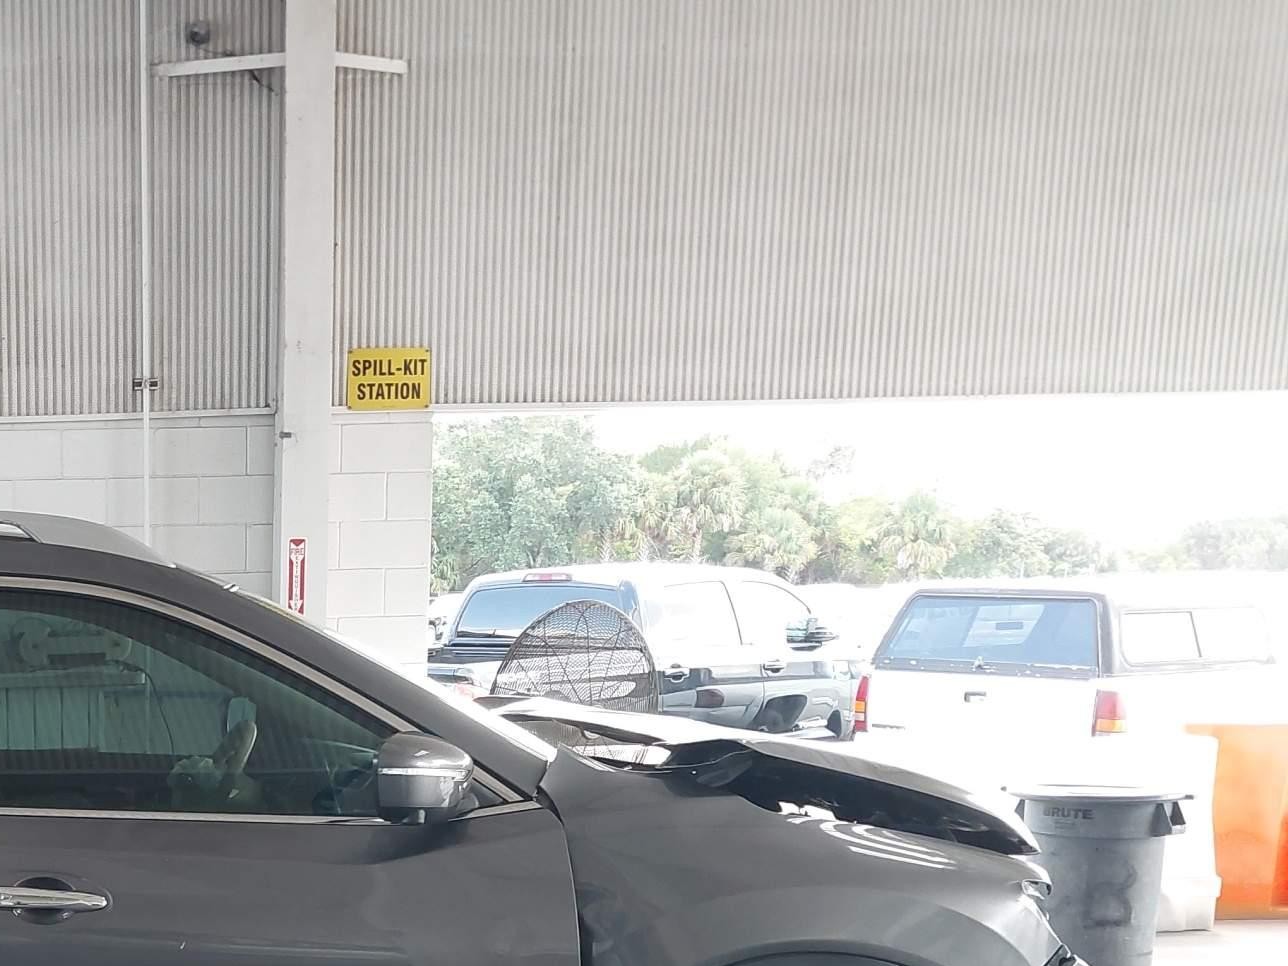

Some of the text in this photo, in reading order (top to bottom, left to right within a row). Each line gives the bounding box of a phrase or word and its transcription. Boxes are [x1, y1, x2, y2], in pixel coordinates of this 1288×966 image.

[352, 359, 427, 376] SPILL-KIT
[357, 382, 421, 400] STATION
[1042, 807, 1096, 820] BRUTE
